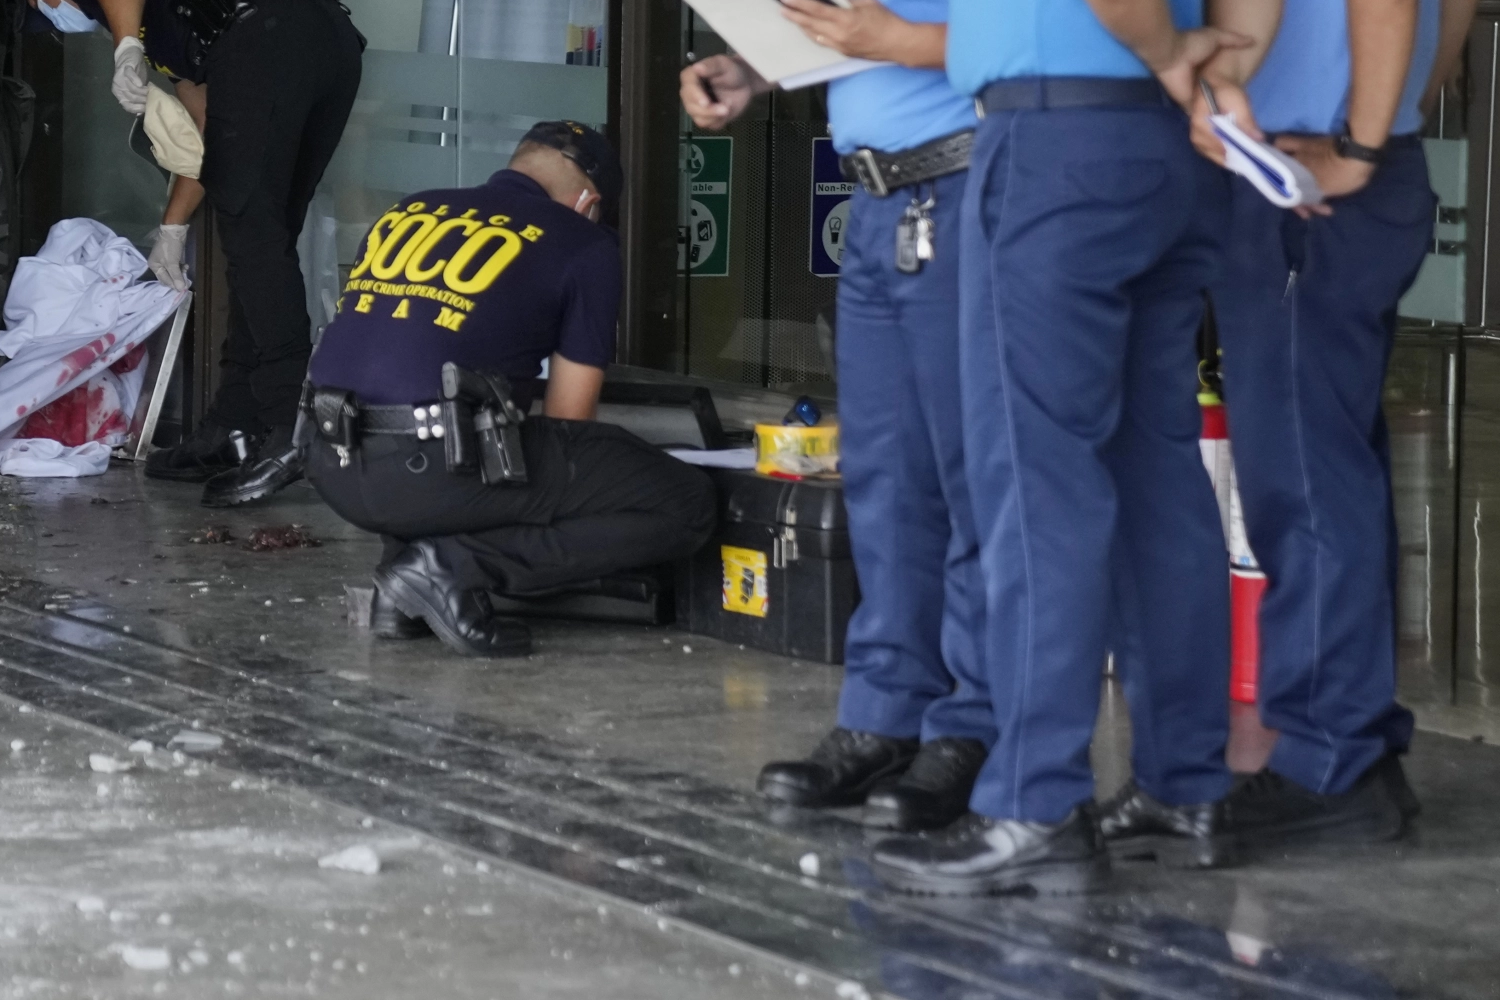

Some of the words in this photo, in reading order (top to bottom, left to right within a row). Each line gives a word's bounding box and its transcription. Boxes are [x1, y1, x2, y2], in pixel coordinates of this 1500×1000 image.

[385, 201, 544, 242] OLICE
[349, 211, 523, 294] SOCO
[373, 281, 407, 296] CRIME
[405, 284, 476, 312] OPERATION
